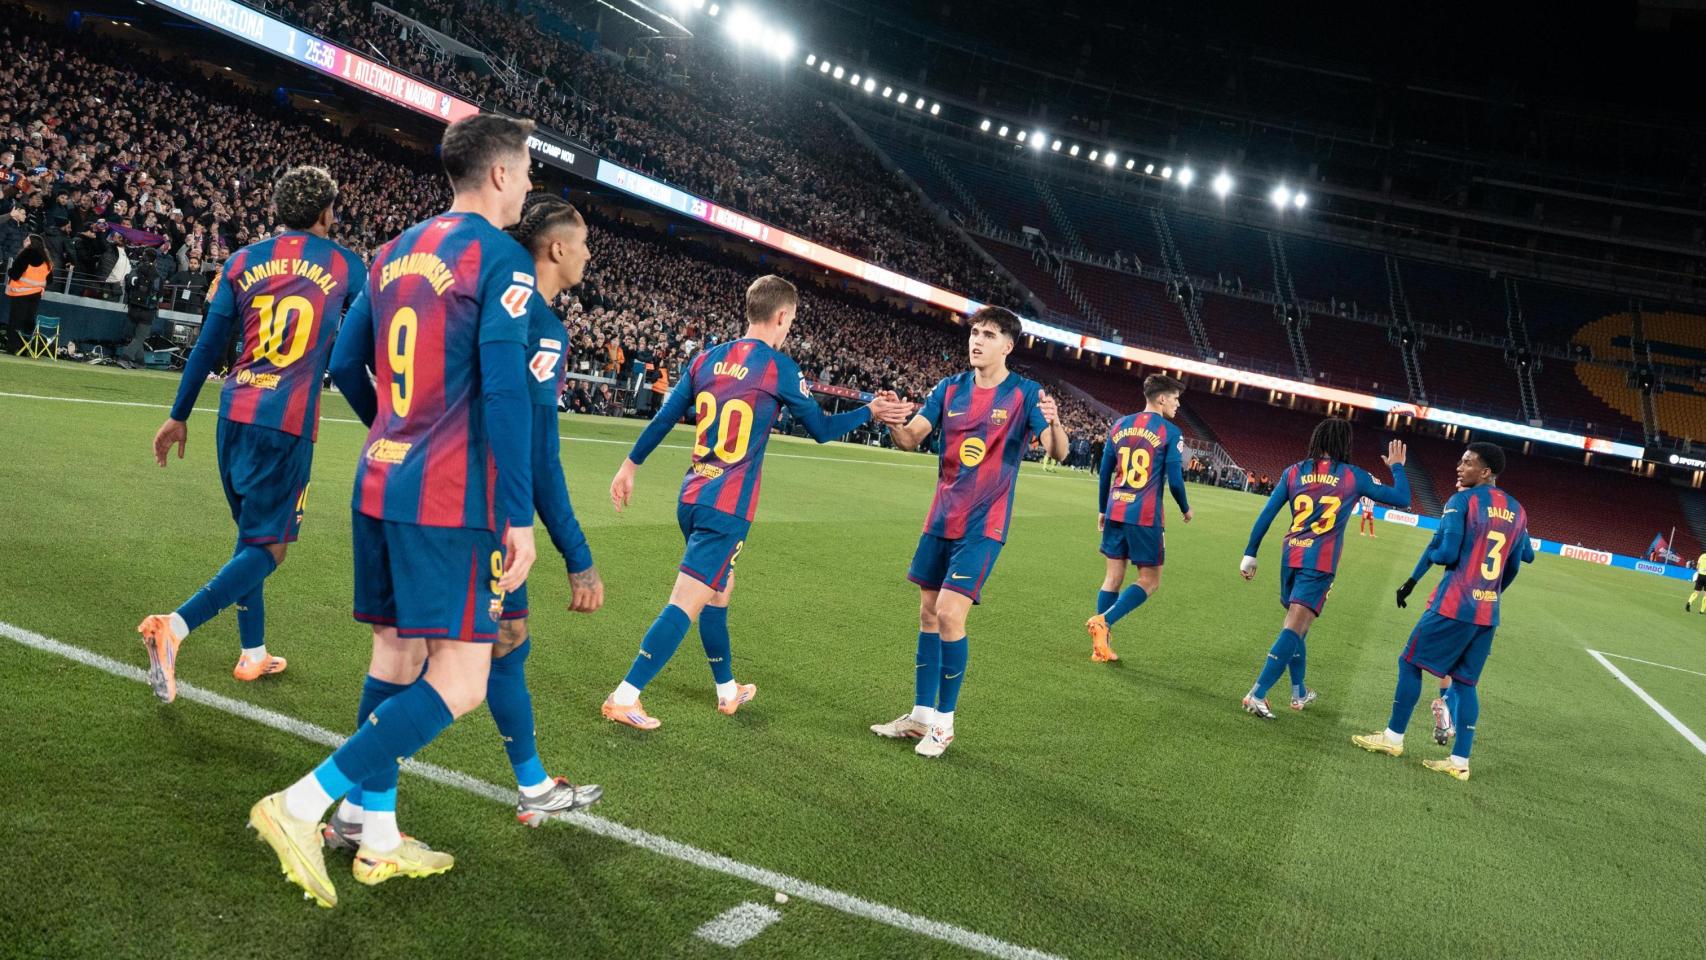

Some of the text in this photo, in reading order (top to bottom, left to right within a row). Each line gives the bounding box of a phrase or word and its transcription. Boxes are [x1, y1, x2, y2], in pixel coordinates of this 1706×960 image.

[190, 0, 265, 40] BARCELONA
[285, 31, 297, 54] 1
[304, 38, 336, 69] 25:36
[342, 54, 352, 78] 1
[392, 74, 406, 98] DE
[405, 81, 437, 111] MADRID
[560, 149, 575, 165] NOU
[237, 259, 338, 295] LAMINE YAMAL
[251, 295, 315, 368] 10
[388, 306, 418, 418] 9
[713, 361, 749, 381] OLMO
[694, 391, 754, 464] 20
[1118, 446, 1150, 489] 18
[1291, 494, 1341, 535] 23
[1387, 512, 1417, 524] BIMBO
[1487, 506, 1515, 523] BALDE
[1480, 530, 1507, 581] 3
[1564, 547, 1609, 565] BIMBO
[1638, 563, 1663, 574] BIMBO
